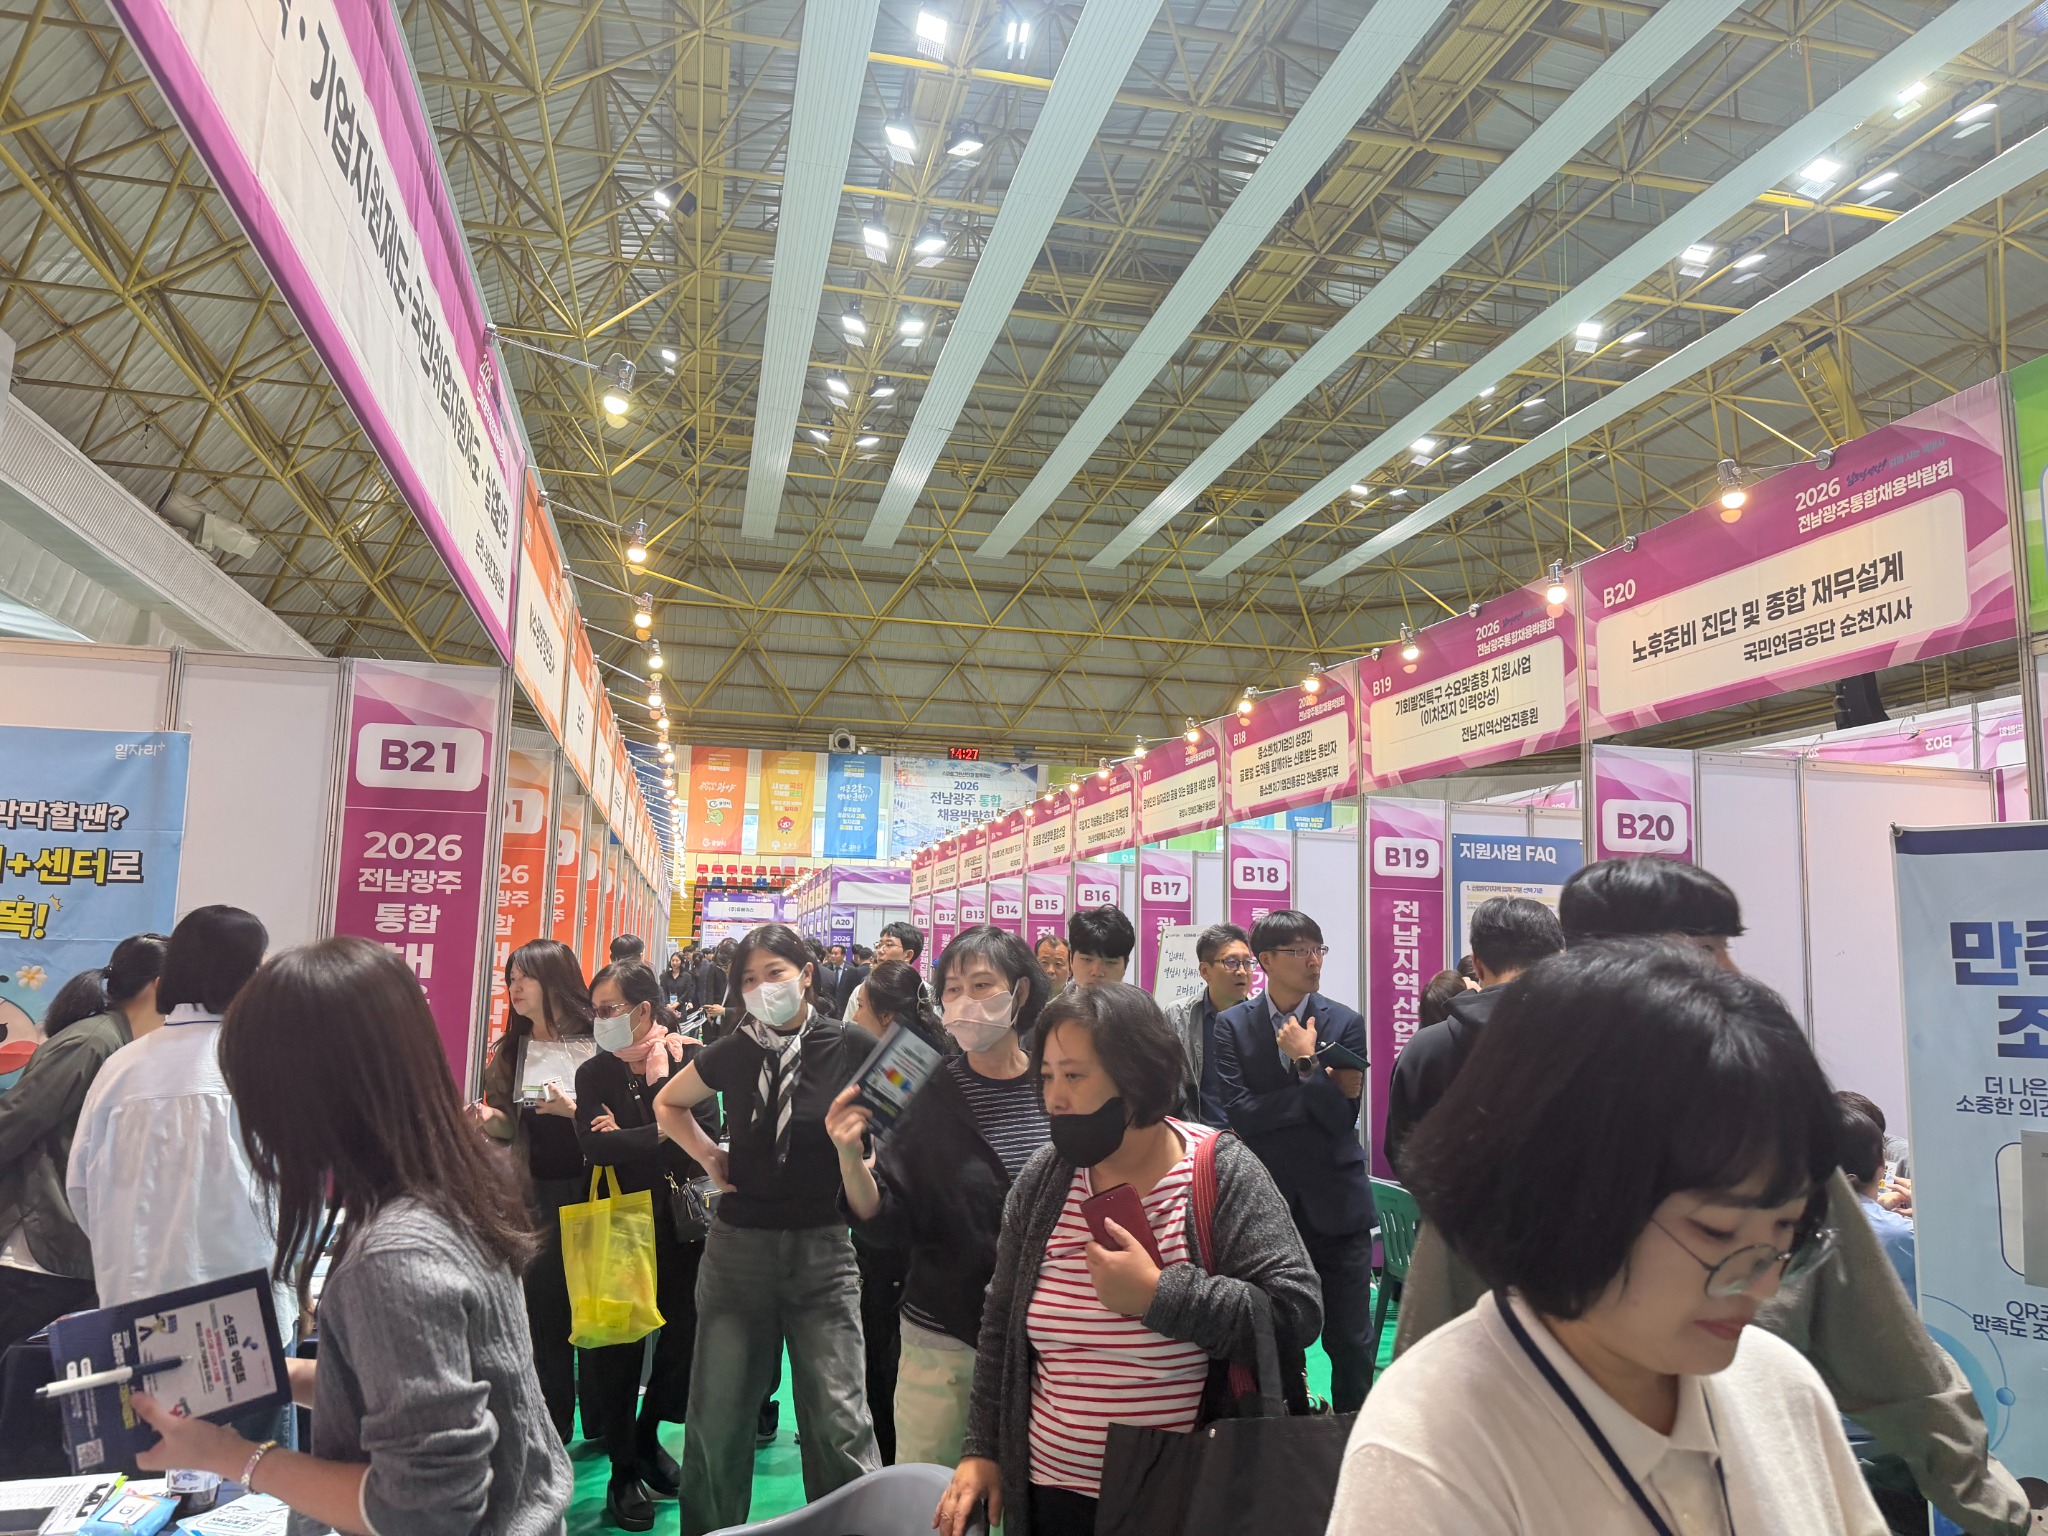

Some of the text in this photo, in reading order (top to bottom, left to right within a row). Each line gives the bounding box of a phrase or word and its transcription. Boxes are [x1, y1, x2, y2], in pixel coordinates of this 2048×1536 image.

[1795, 477, 1840, 512] 2026
[1798, 458, 1954, 533] 전남광주통합채용박람회
[1603, 579, 1636, 608] B20
[1632, 552, 1904, 664] 노후준비 진단 및 종합 재무설계
[1476, 620, 1500, 641] 2026
[1477, 618, 1555, 658] 전남광주통합채용박람회
[1744, 597, 1913, 662] 국민연금공단 순천지사
[1372, 677, 1391, 696] B19
[1395, 655, 1531, 716] 기회발전특구 수요맞춤형 지원사업
[1421, 686, 1500, 727] (이차전지 인력양성)
[1462, 707, 1539, 743] 전남지역산업진흥원
[1233, 731, 1246, 746] B18
[1318, 740, 1337, 758] 동반자
[379, 738, 457, 774] B21
[950, 748, 979, 760] 14:27
[954, 781, 979, 791] 2026
[930, 792, 1002, 807] 전남광주 통합
[1617, 813, 1674, 842] B20
[363, 831, 463, 862] 2026
[1460, 843, 1557, 864] 지원사업 FAQ
[0, 846, 144, 885] +센터로
[1385, 847, 1429, 869] B19
[358, 867, 462, 895] 전남광주
[1242, 866, 1279, 883] B18
[1084, 889, 1111, 902] B16
[1151, 882, 1181, 896] B17
[966, 911, 984, 919] B13
[997, 906, 1018, 915] B14
[1035, 900, 1058, 910] B15
[375, 904, 441, 934] 통합
[939, 913, 956, 922] B12
[1393, 900, 1421, 1059] 전남지역산업
[1985, 1077, 2048, 1096] 더 나은
[1956, 1095, 2014, 1116] 소중한
[1973, 1314, 2027, 1338] 만족도
